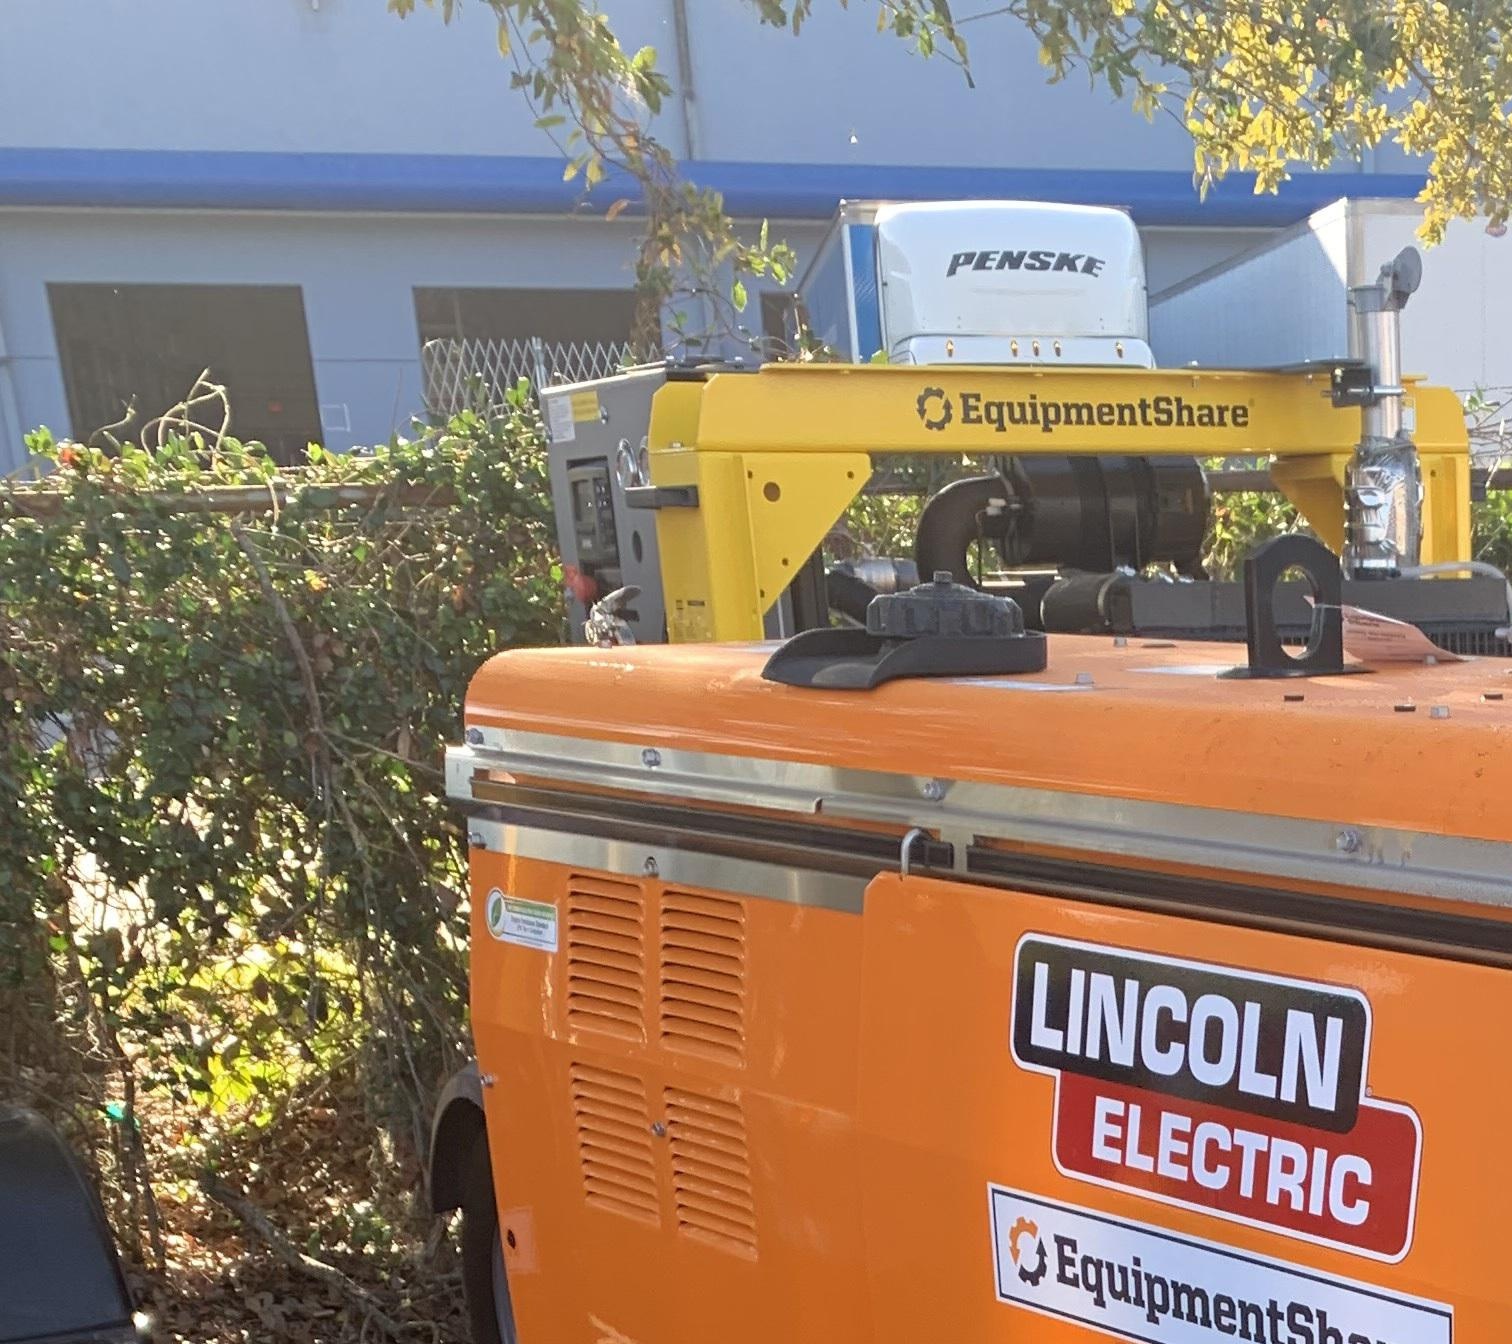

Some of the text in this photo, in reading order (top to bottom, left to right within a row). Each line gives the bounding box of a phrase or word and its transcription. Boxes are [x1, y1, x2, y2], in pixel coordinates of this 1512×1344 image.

[946, 250, 1106, 278] PENSKE
[960, 393, 1249, 432] EquipmentShare
[1029, 960, 1344, 1113] LINCOLN
[1091, 1095, 1373, 1227] ELECTRIC
